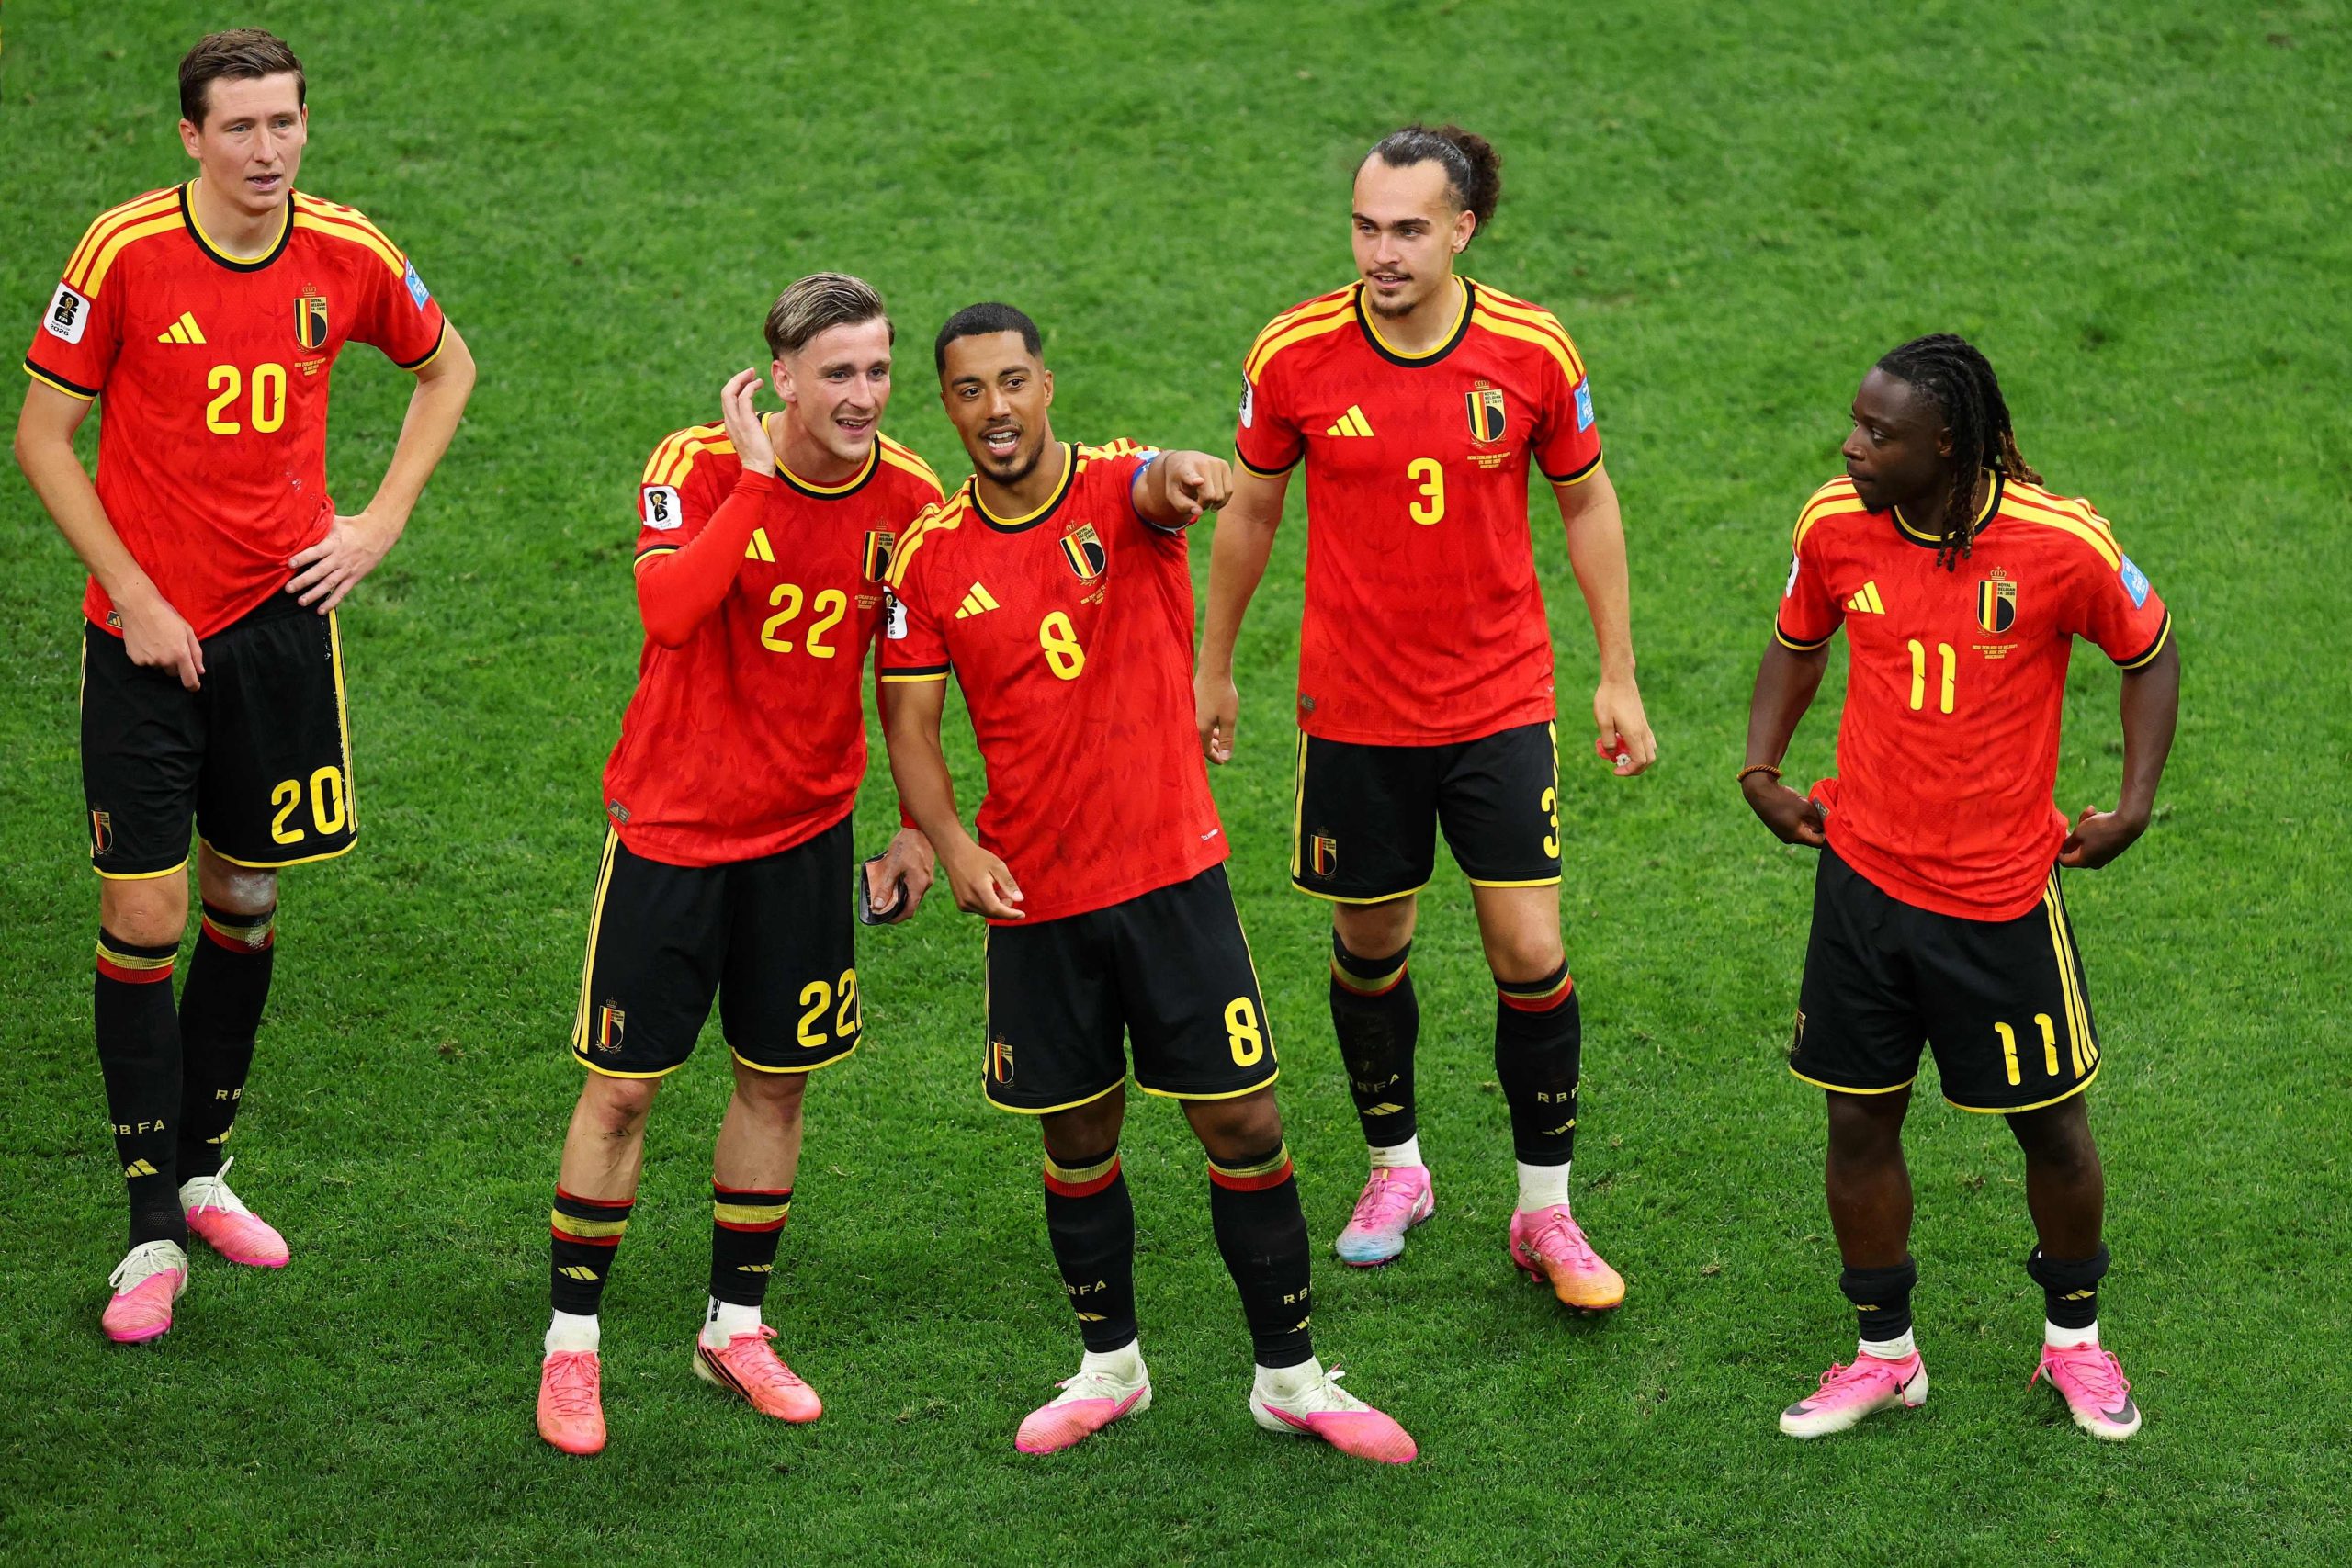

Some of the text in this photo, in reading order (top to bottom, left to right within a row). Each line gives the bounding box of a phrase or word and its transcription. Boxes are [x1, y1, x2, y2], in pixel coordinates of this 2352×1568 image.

[51, 324, 69, 336] 2026
[207, 364, 286, 434] 20
[1407, 457, 1445, 525] 3
[761, 583, 847, 659] 22
[1039, 611, 1086, 681] 8
[1907, 638, 1956, 714] 11
[271, 765, 345, 844] 20
[1541, 786, 1560, 858] 3
[797, 968, 856, 1047] 22
[1225, 996, 1263, 1066] 8
[1350, 1074, 1400, 1093] BFA
[1994, 1013, 2060, 1085] 11
[216, 1087, 244, 1100] RB
[1064, 1280, 1106, 1295] BFA
[1283, 1281, 1311, 1305] RB
